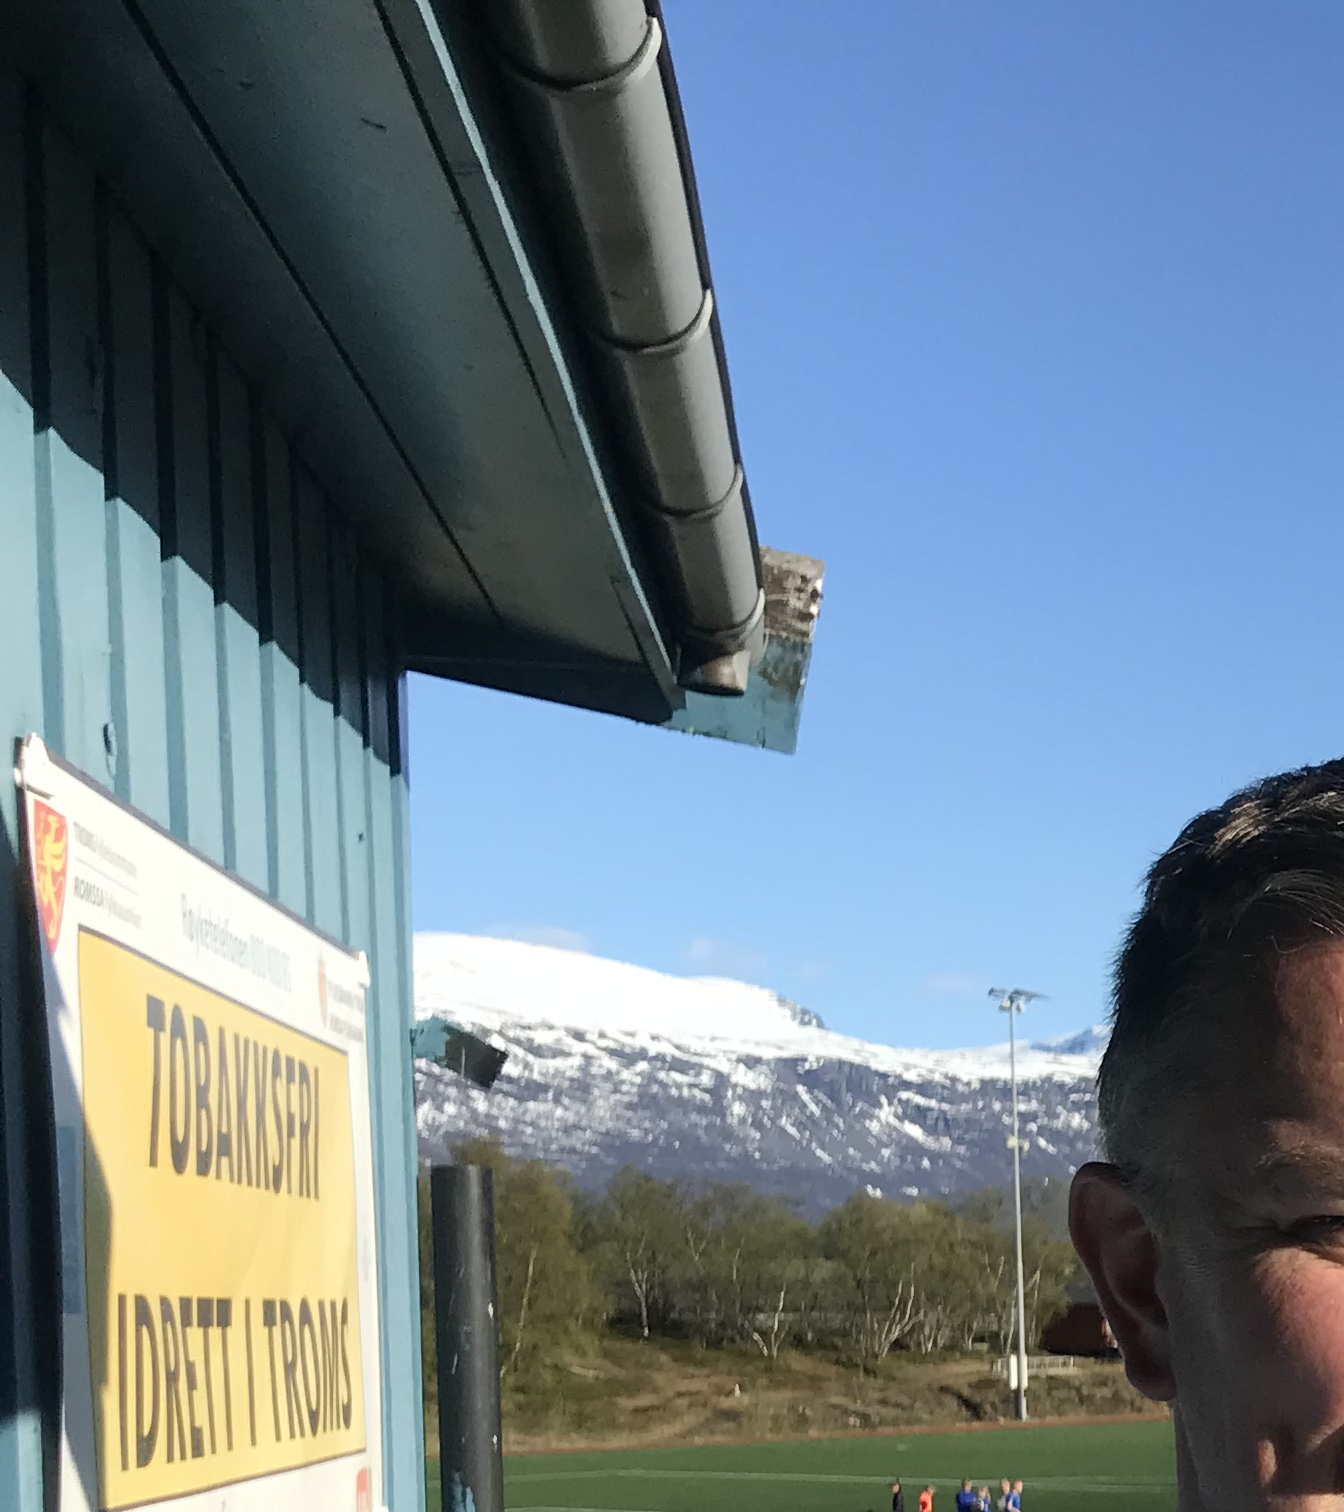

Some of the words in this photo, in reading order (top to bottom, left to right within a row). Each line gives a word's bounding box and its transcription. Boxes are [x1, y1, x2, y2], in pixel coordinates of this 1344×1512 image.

[146, 993, 320, 1201] TOBAKKSFRI
[117, 1293, 232, 1472] IDRETT
[244, 1296, 258, 1448] I
[262, 1295, 353, 1443] TROMS
